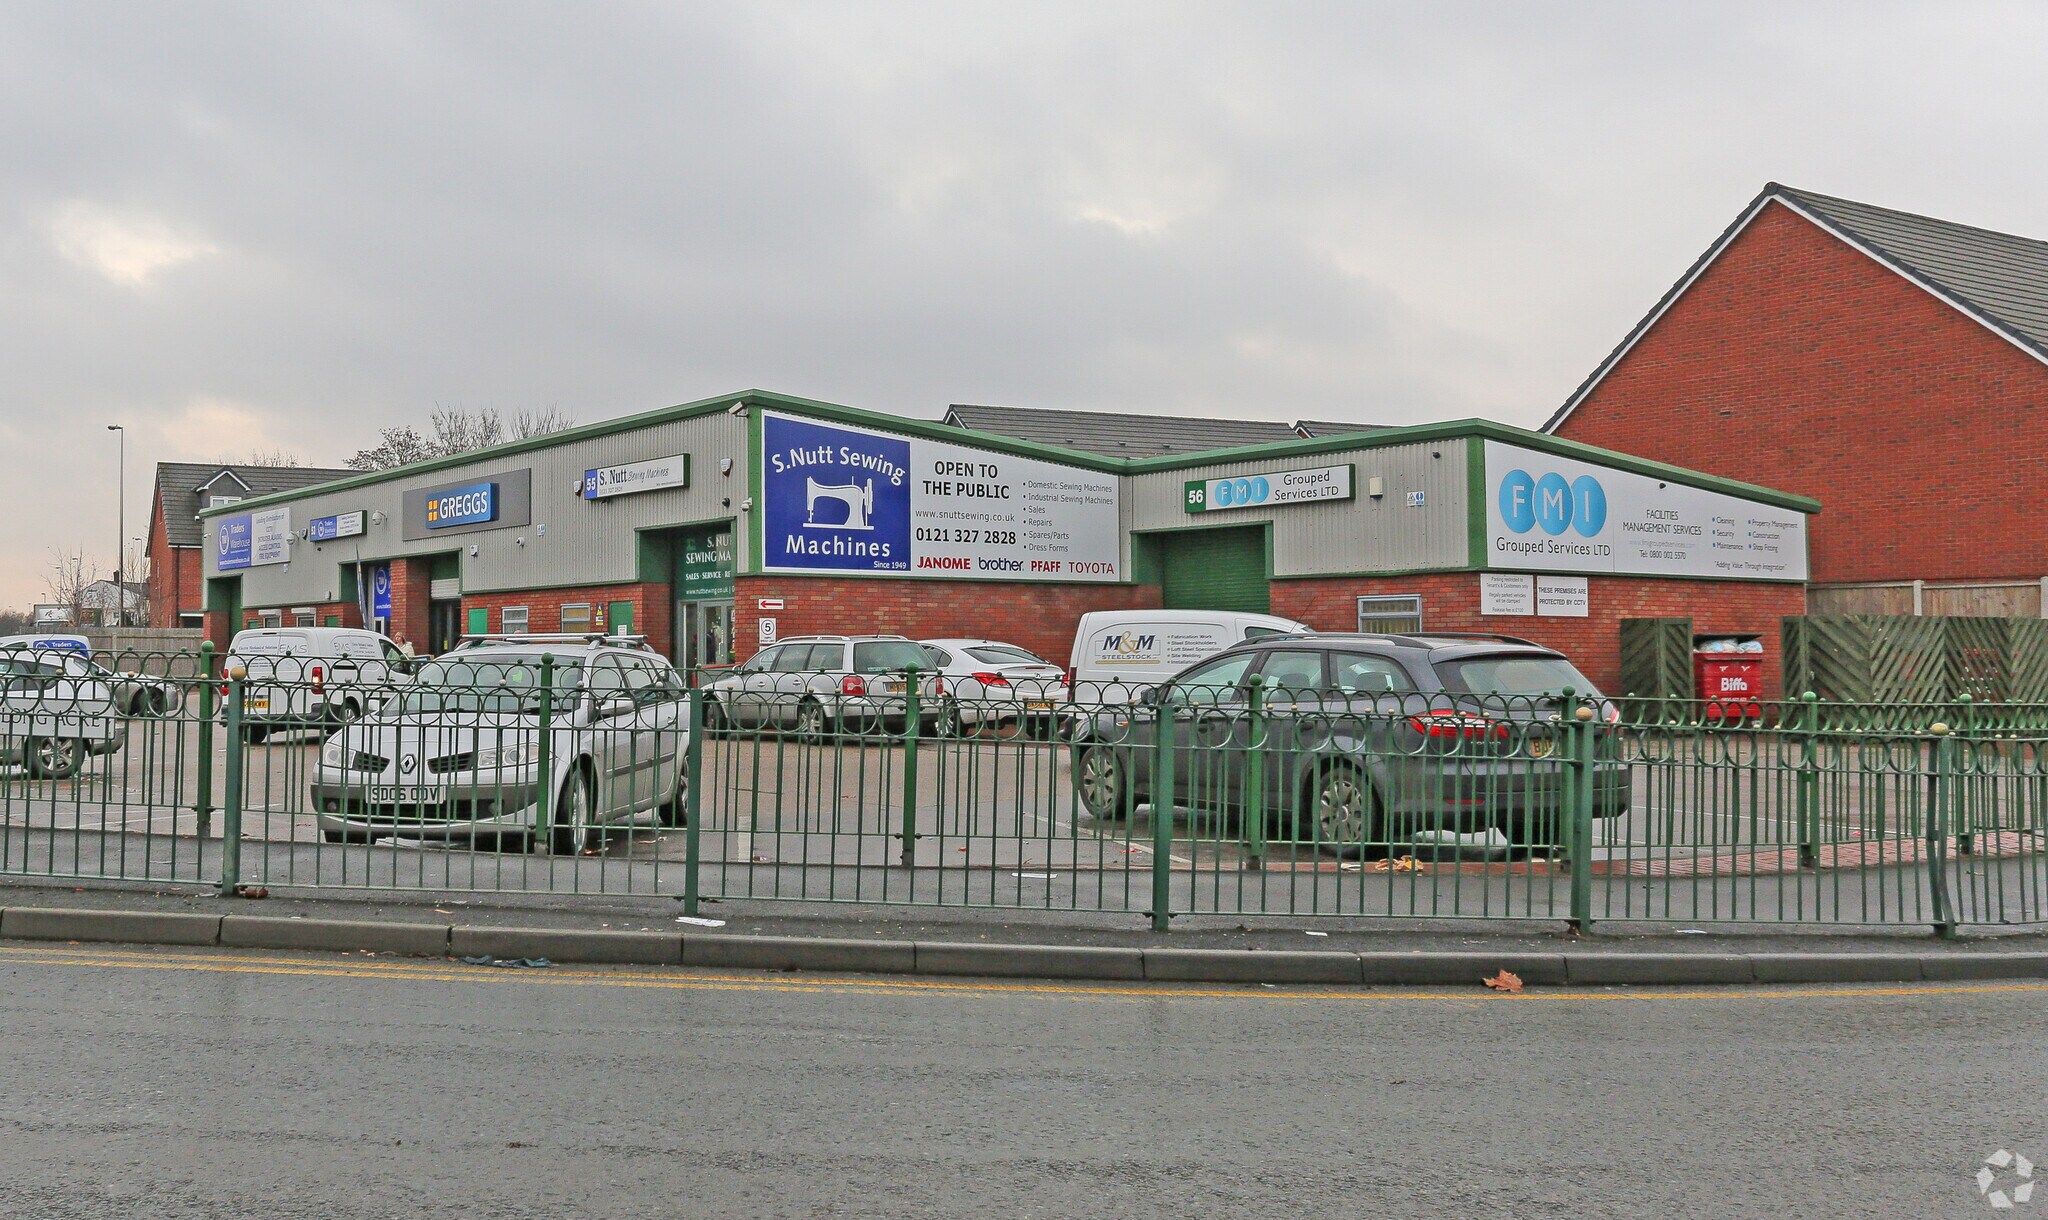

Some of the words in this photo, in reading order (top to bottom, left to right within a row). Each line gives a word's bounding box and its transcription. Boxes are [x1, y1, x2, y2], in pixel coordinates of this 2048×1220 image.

[771, 446, 834, 474] S.Nutt
[840, 446, 906, 486] Sewing
[934, 461, 974, 477] OPEN
[979, 464, 998, 478] TO
[600, 471, 607, 486] S.
[610, 469, 627, 484] Nutt
[628, 470, 645, 483] Sewing
[646, 467, 669, 478] Machines
[1284, 470, 1330, 486] Grouped
[586, 477, 596, 491] 55
[923, 481, 951, 496] THE
[956, 482, 1009, 499] PUBLIC
[1028, 481, 1058, 490] Domestic
[1060, 482, 1082, 492] Sewing
[1084, 484, 1112, 492] Machines
[1028, 493, 1059, 502] Industrial
[1060, 495, 1083, 505] Sewing
[1085, 496, 1113, 505] Machines
[1188, 489, 1204, 504] 56
[1275, 488, 1317, 500] Services
[1321, 486, 1339, 497] LTD
[440, 491, 487, 519] GREGGS
[1028, 505, 1046, 514] Sales
[916, 510, 1015, 522] www.snuttsewing.co.uk
[1647, 509, 1678, 520] FACILITIES
[230, 523, 245, 534] Traders
[1028, 518, 1053, 527] Repairs
[1623, 522, 1671, 533] MANAGEMENT
[1673, 525, 1702, 536] SERVICES
[707, 537, 714, 548] S.
[916, 528, 949, 541] 0121
[955, 529, 979, 542] 327
[984, 531, 1016, 544] 2828
[1029, 531, 1069, 540] Spares/Parts
[785, 534, 890, 557] Machines
[1029, 543, 1047, 551] Dress
[1049, 544, 1068, 552] Forms
[1496, 536, 1544, 556] Grouped
[1548, 540, 1590, 556] Services
[1593, 545, 1611, 556] LTD
[686, 551, 717, 564] SEWING
[718, 550, 731, 561] MA
[873, 560, 890, 568] Since
[891, 561, 907, 569] 1949
[917, 556, 971, 570] JANOME
[979, 557, 1024, 571] brother
[1031, 560, 1061, 572] PFAFF
[1068, 562, 1114, 574] TOYOTA
[702, 571, 721, 579] SERVICE
[765, 622, 771, 632] 5
[1103, 630, 1156, 654] M&M
[1721, 677, 1748, 691] Biffa
[1, 708, 47, 725] LONG
[57, 710, 100, 727] ACRE
